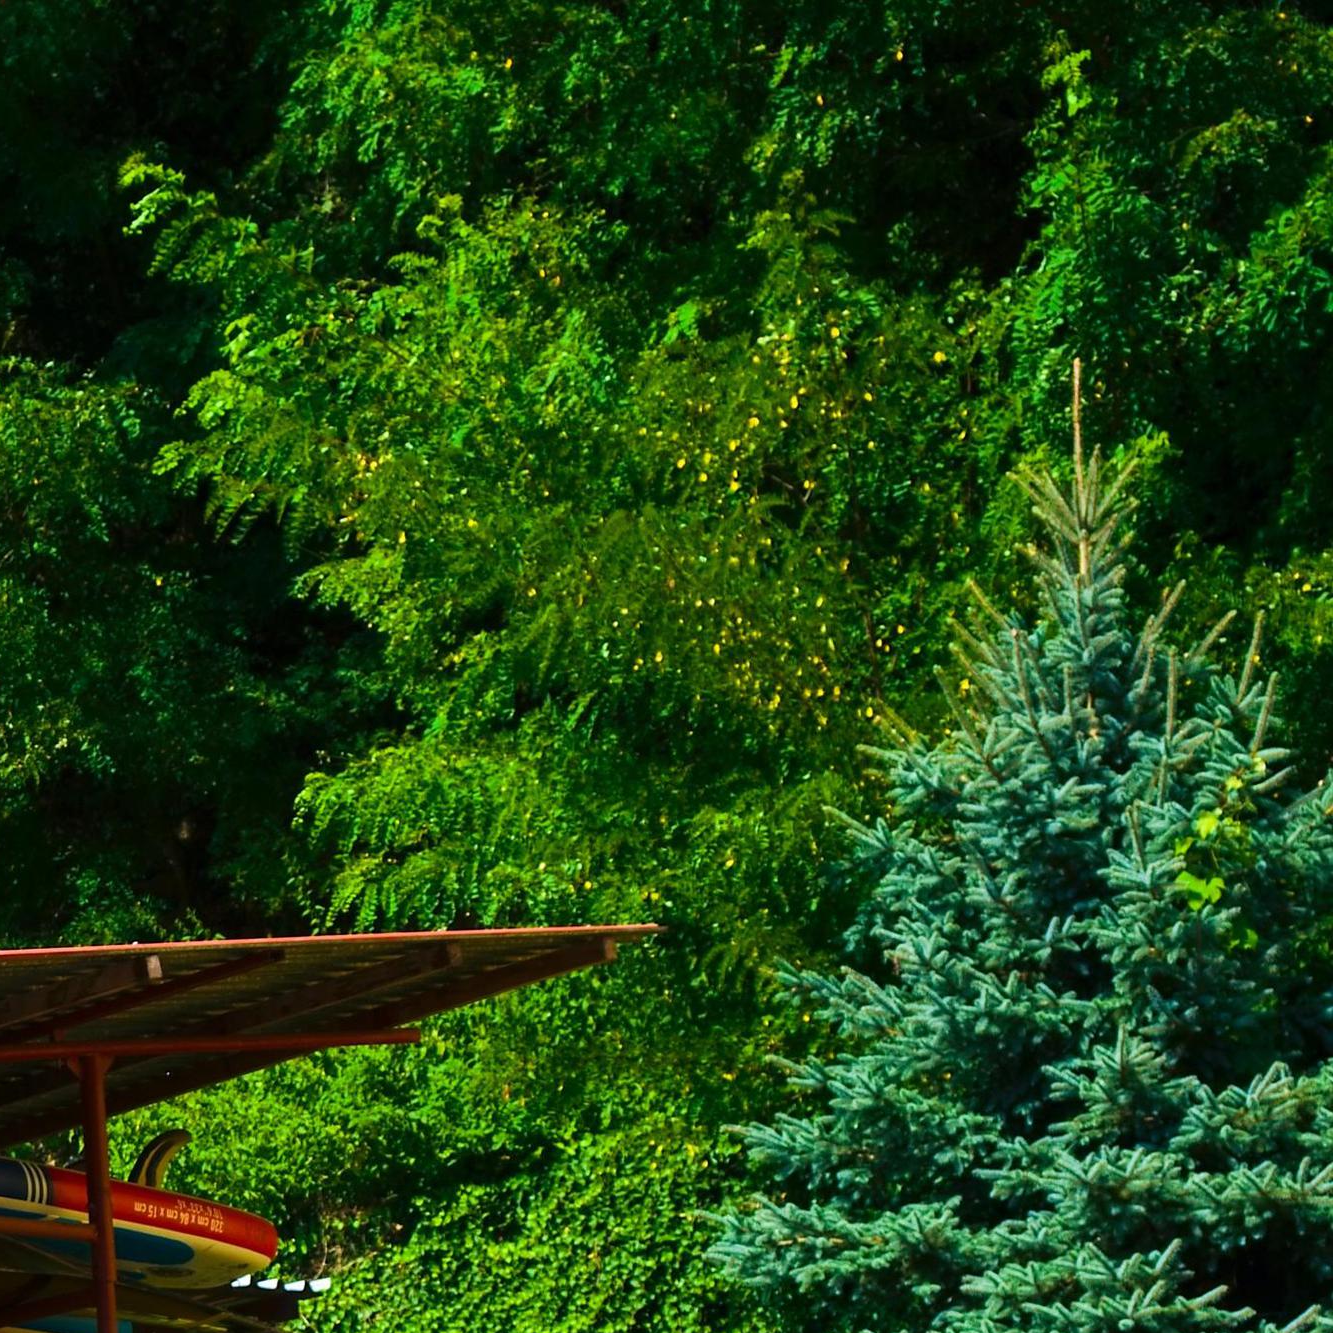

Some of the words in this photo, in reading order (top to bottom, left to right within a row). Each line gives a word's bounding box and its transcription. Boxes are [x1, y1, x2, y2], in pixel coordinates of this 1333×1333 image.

[134, 1201, 147, 1214] cm
[166, 1208, 178, 1220] cm
[197, 1215, 209, 1227] cm
